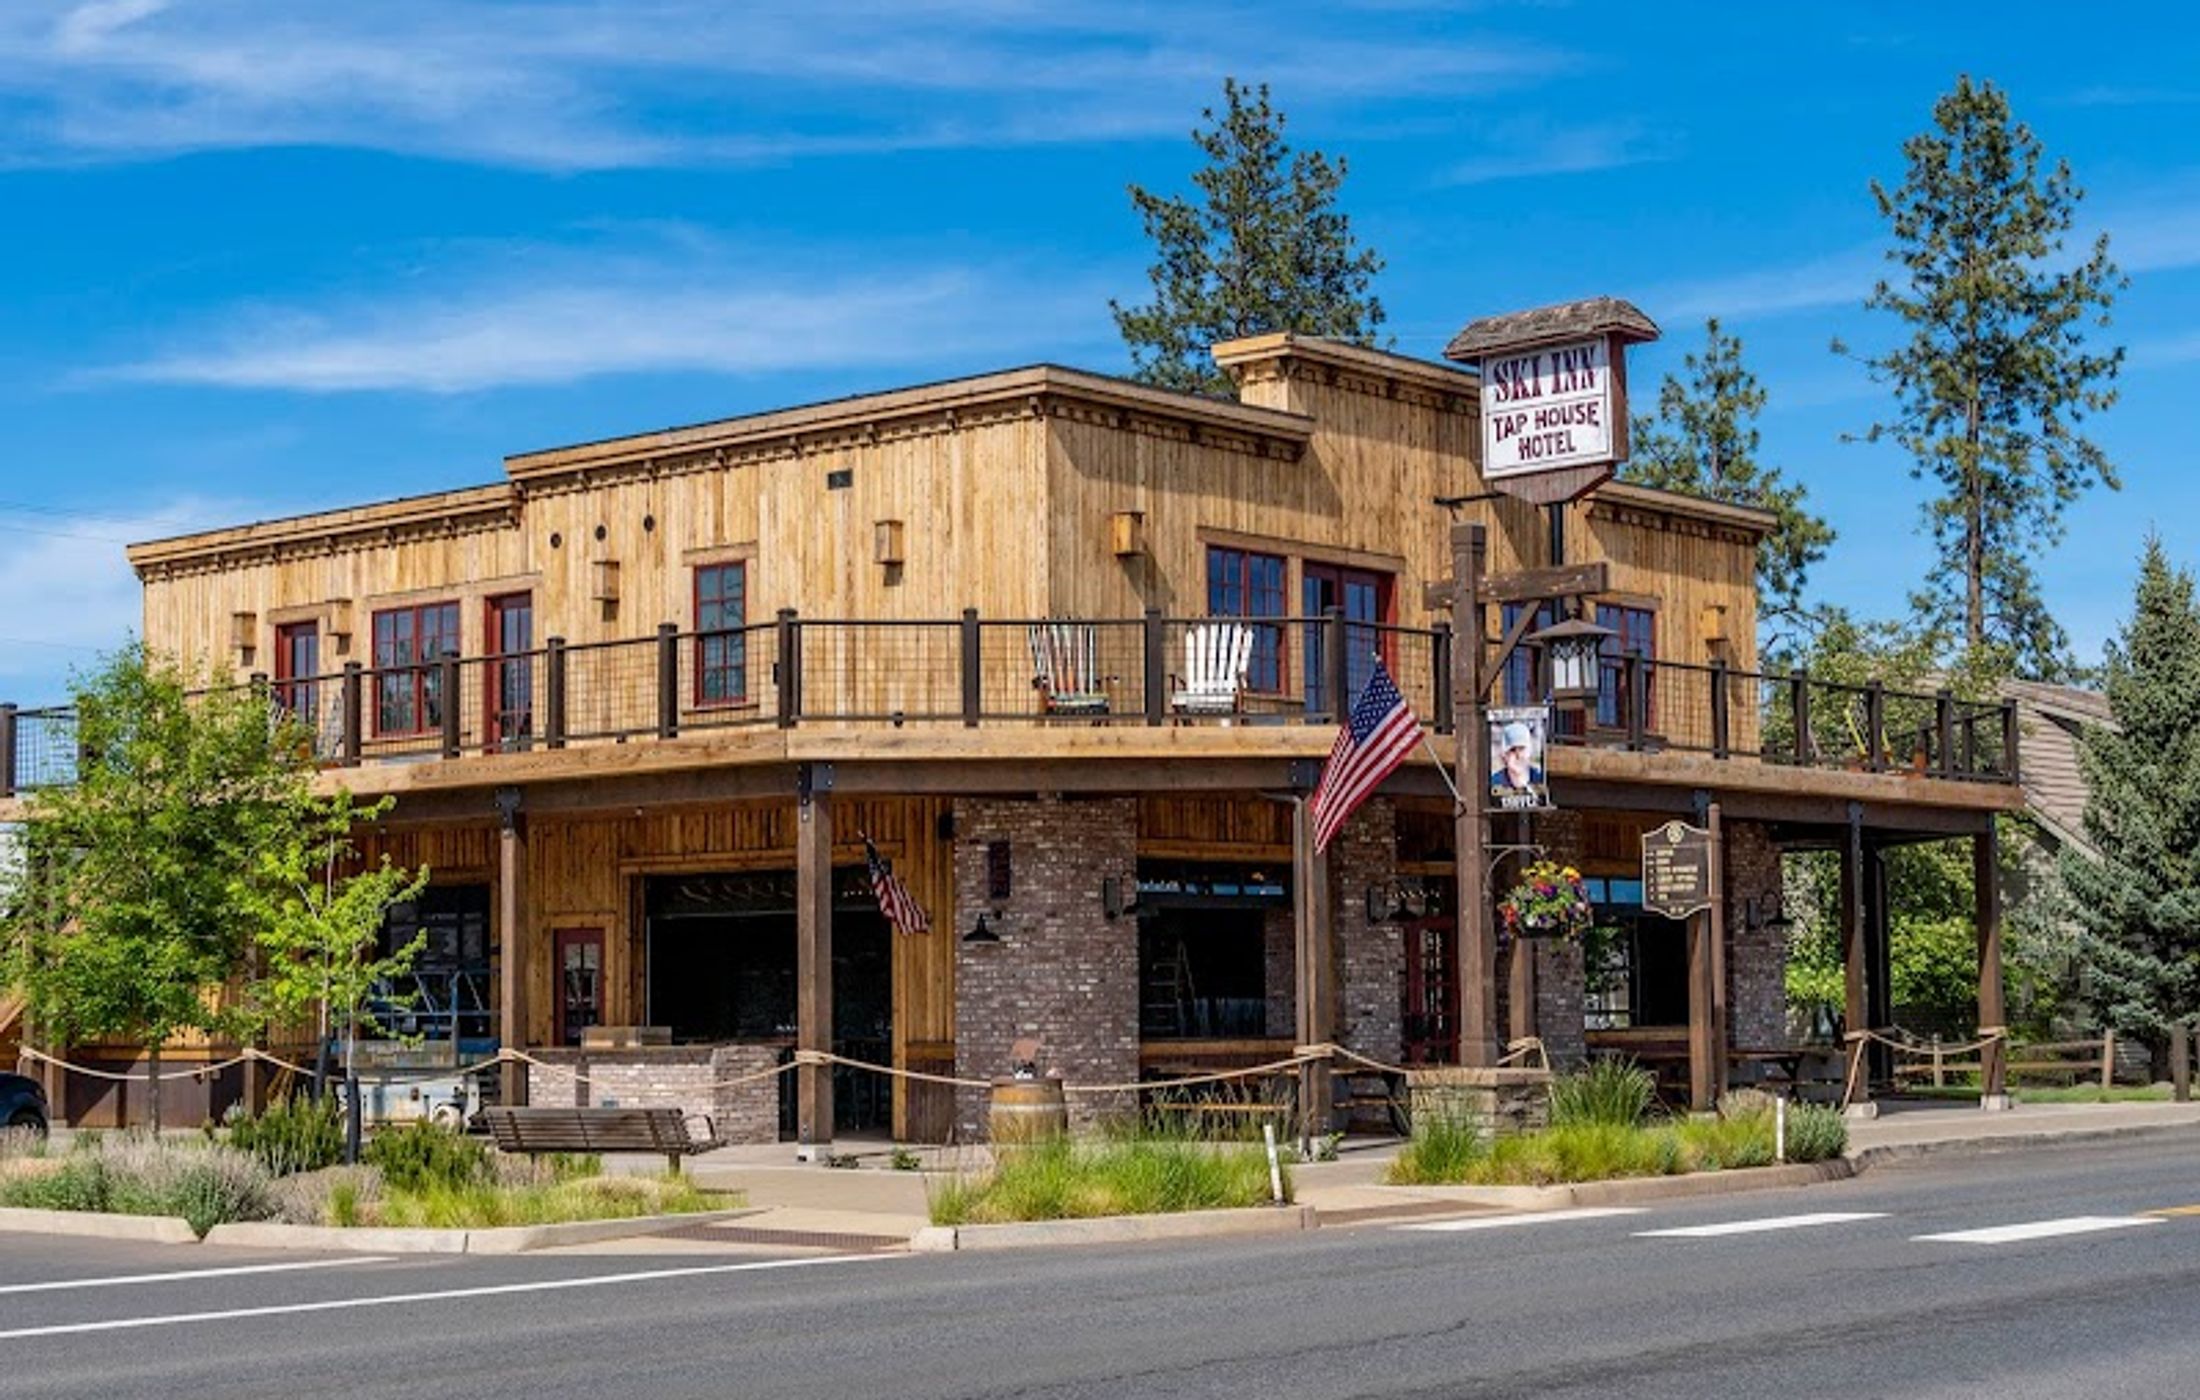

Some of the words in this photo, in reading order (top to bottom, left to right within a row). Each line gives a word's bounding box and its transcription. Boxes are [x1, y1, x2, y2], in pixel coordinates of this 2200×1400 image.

[1493, 356, 1542, 403] SKI
[1551, 345, 1597, 394] INN
[1493, 414, 1527, 443] TAP
[1535, 401, 1600, 428] HOUSE
[1518, 431, 1576, 461] HOTEL
